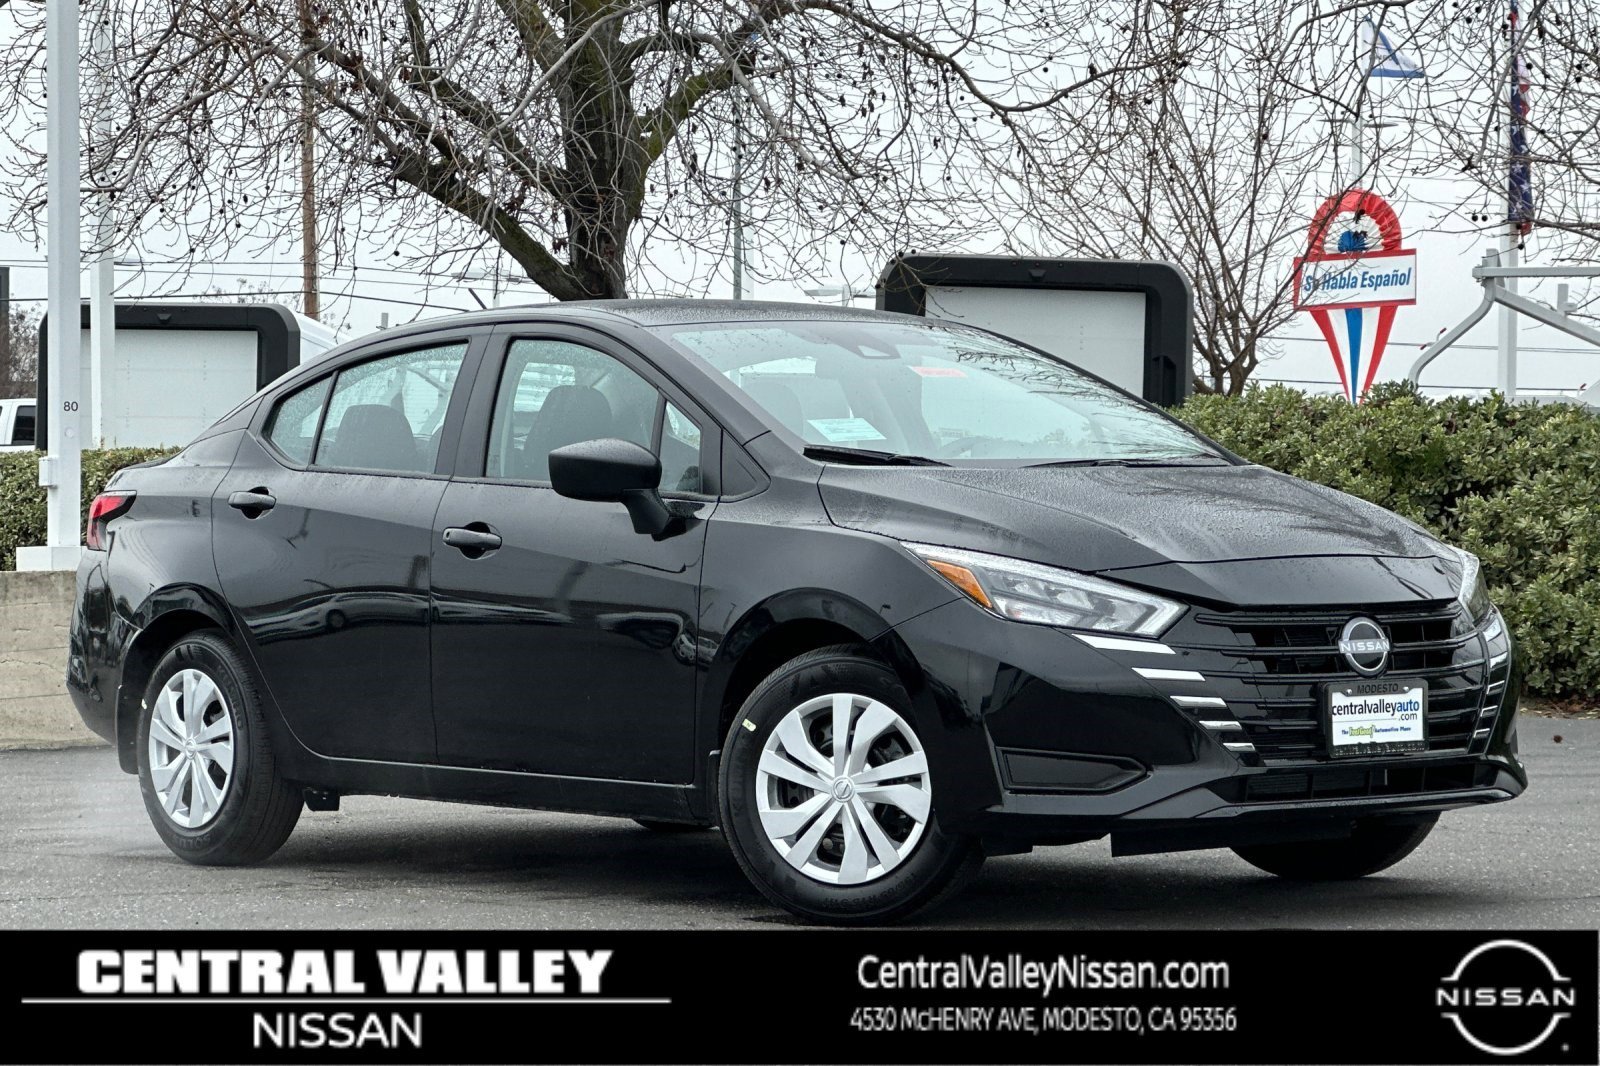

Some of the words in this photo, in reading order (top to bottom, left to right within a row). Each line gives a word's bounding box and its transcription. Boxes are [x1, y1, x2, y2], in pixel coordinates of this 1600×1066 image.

[1321, 271, 1358, 290] Habla
[1360, 267, 1412, 291] Español
[63, 401, 79, 412] 80
[1340, 641, 1390, 652] NISSAN
[1357, 683, 1399, 694] MODESTO
[1331, 698, 1420, 716] centralvalleyauto
